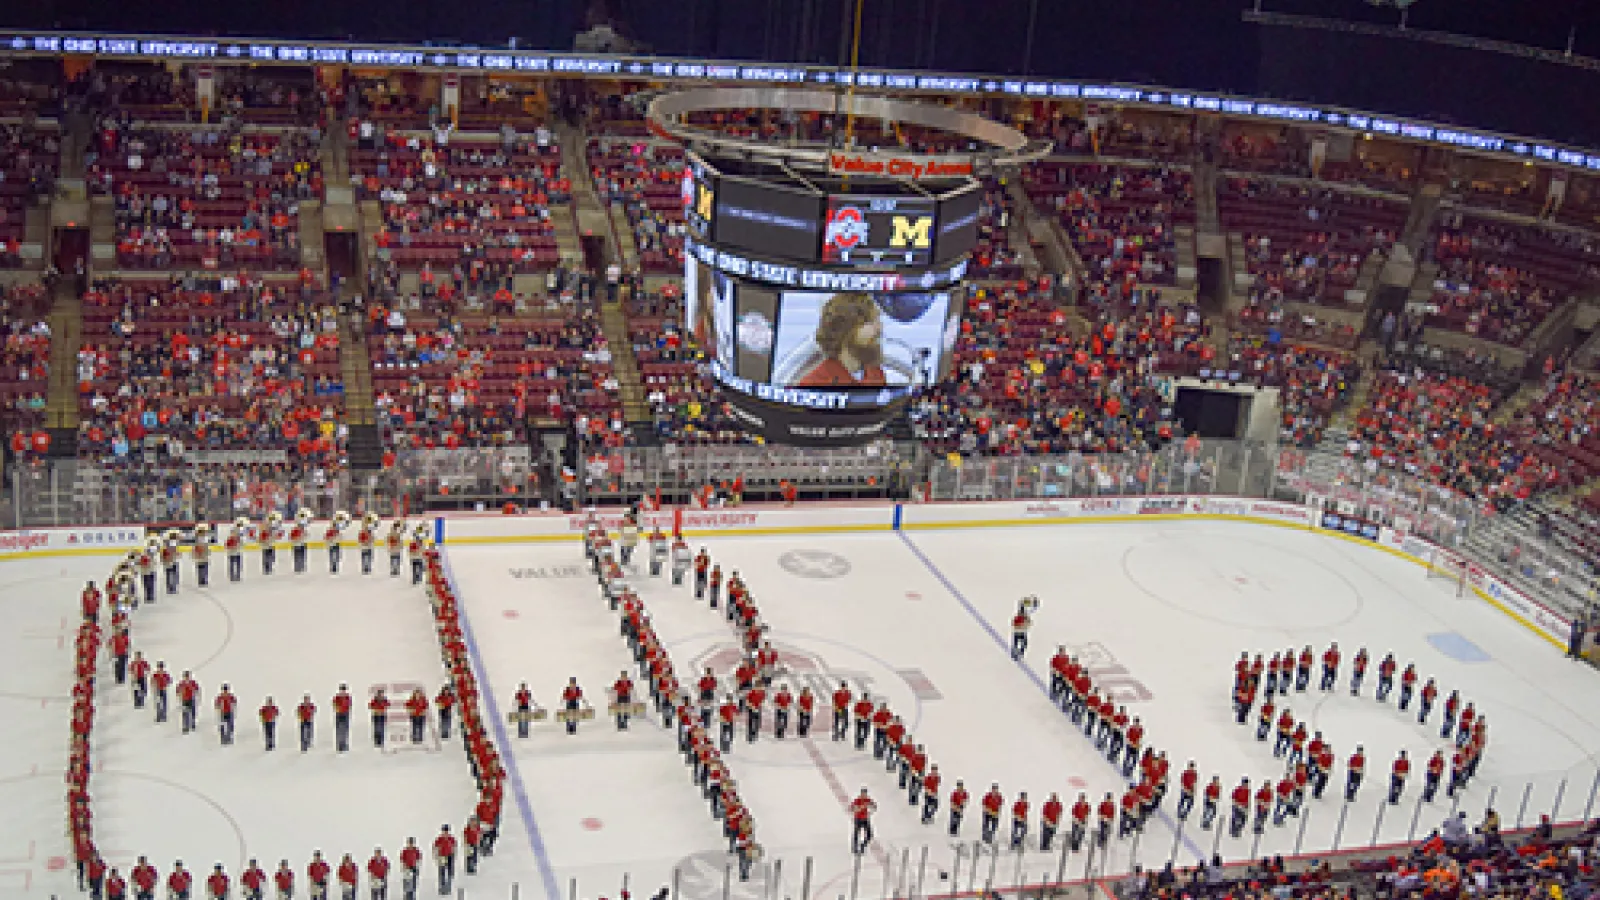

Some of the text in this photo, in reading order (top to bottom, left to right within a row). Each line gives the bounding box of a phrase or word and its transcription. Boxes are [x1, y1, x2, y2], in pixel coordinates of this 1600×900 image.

[35, 37, 218, 57] THE OHIO STATE UNIVERSITY
[250, 44, 424, 64] THE OHIO STATE UNIVERSITY
[457, 54, 478, 67] THE
[483, 56, 512, 69] OHIO
[515, 57, 548, 70] STATE
[831, 155, 972, 179] Value City Arena
[890, 216, 932, 249] M
[719, 249, 747, 275] OHIO
[751, 260, 798, 284] STATE
[802, 270, 904, 290] UNIVERSITY
[757, 382, 849, 409] UNIVERSITY
[83, 532, 138, 544] DELTA
